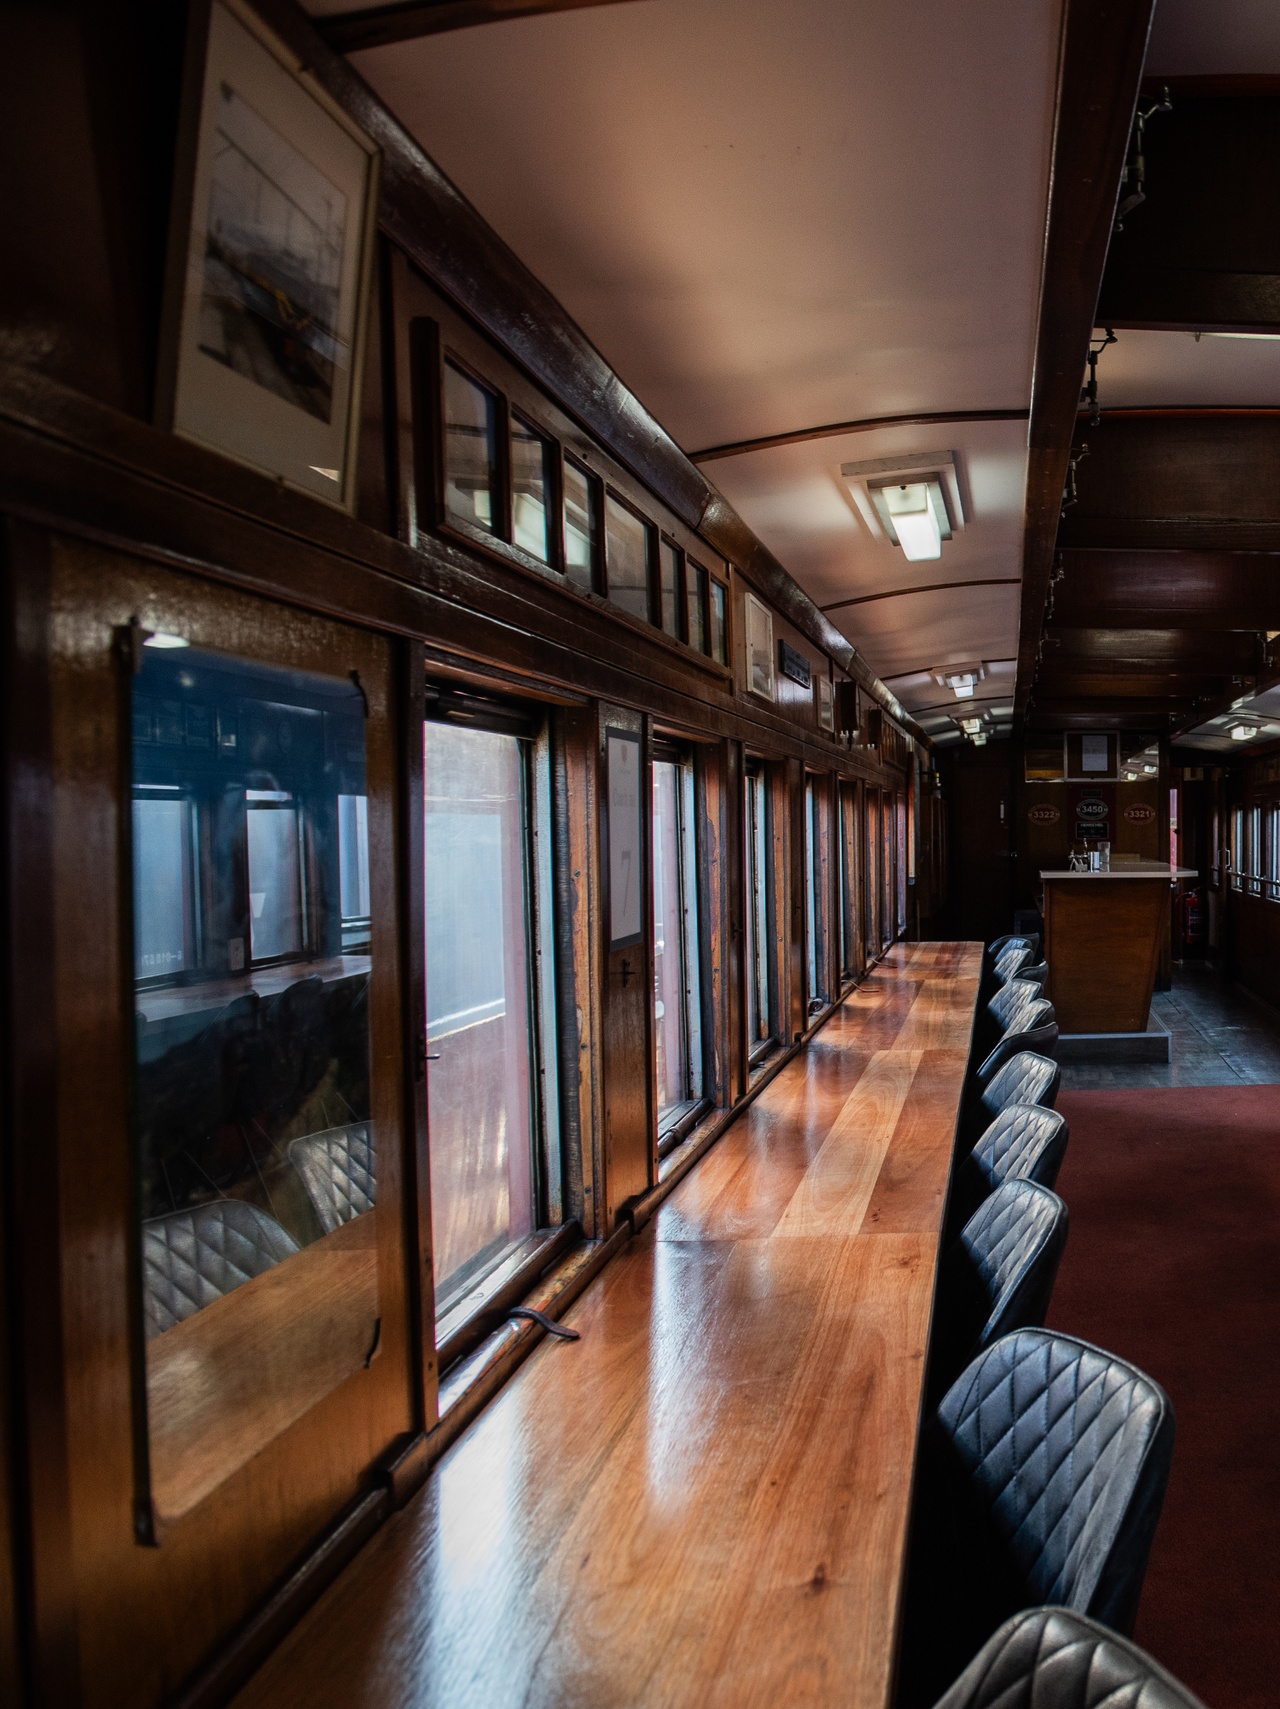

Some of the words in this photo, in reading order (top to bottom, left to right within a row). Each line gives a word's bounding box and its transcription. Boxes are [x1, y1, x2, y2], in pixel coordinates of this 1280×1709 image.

[1081, 805, 1103, 813] 3450
[1033, 811, 1055, 819] 3322
[1128, 810, 1150, 818] 3321
